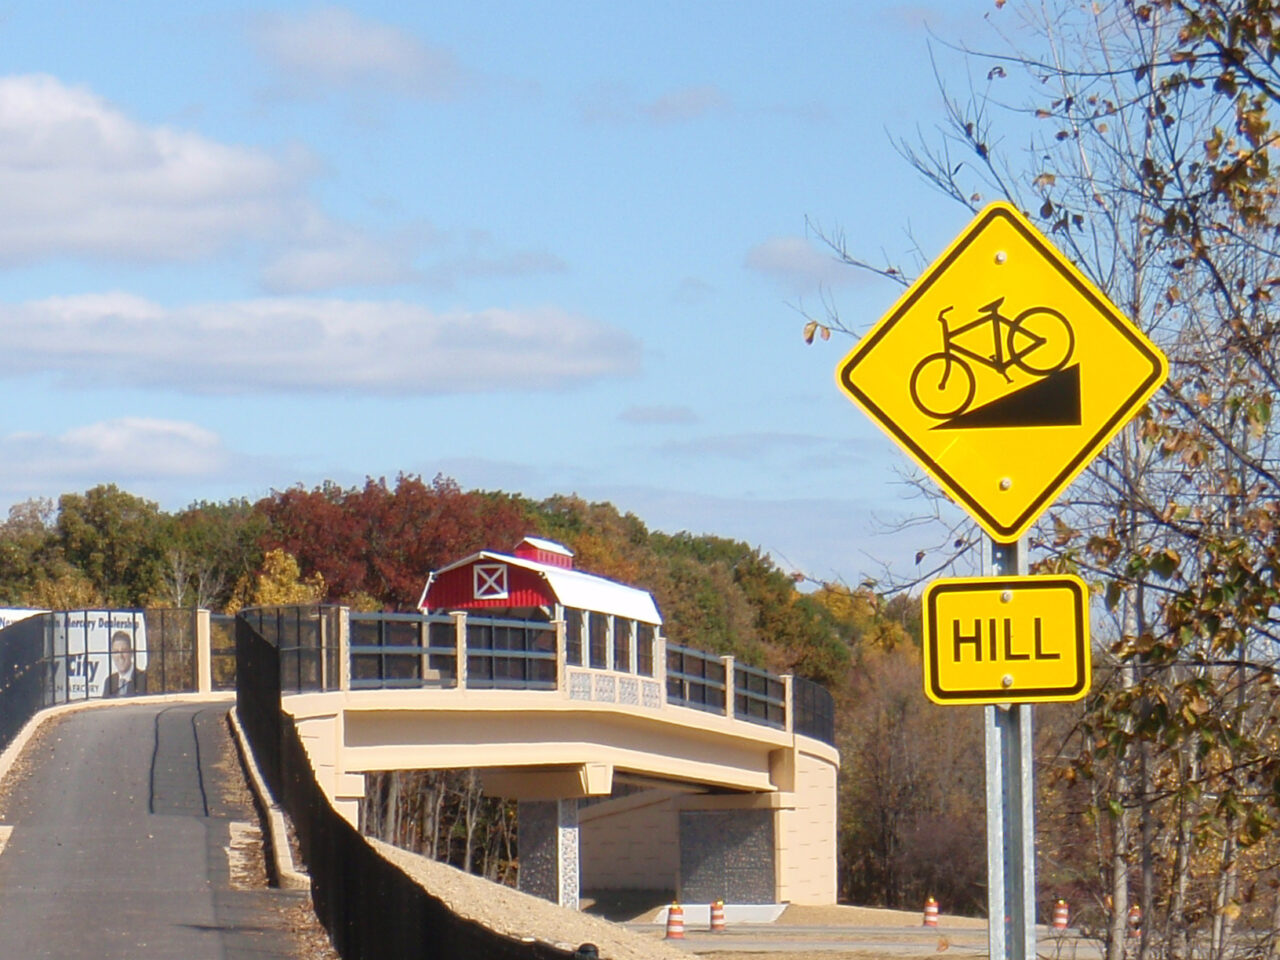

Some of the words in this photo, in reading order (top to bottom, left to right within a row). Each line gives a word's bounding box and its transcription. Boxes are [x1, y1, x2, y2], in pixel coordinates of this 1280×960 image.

[64, 617, 95, 631] ercry
[98, 616, 140, 631] Dealershp
[953, 618, 1060, 662] HILL
[66, 684, 99, 692] ERCRY
